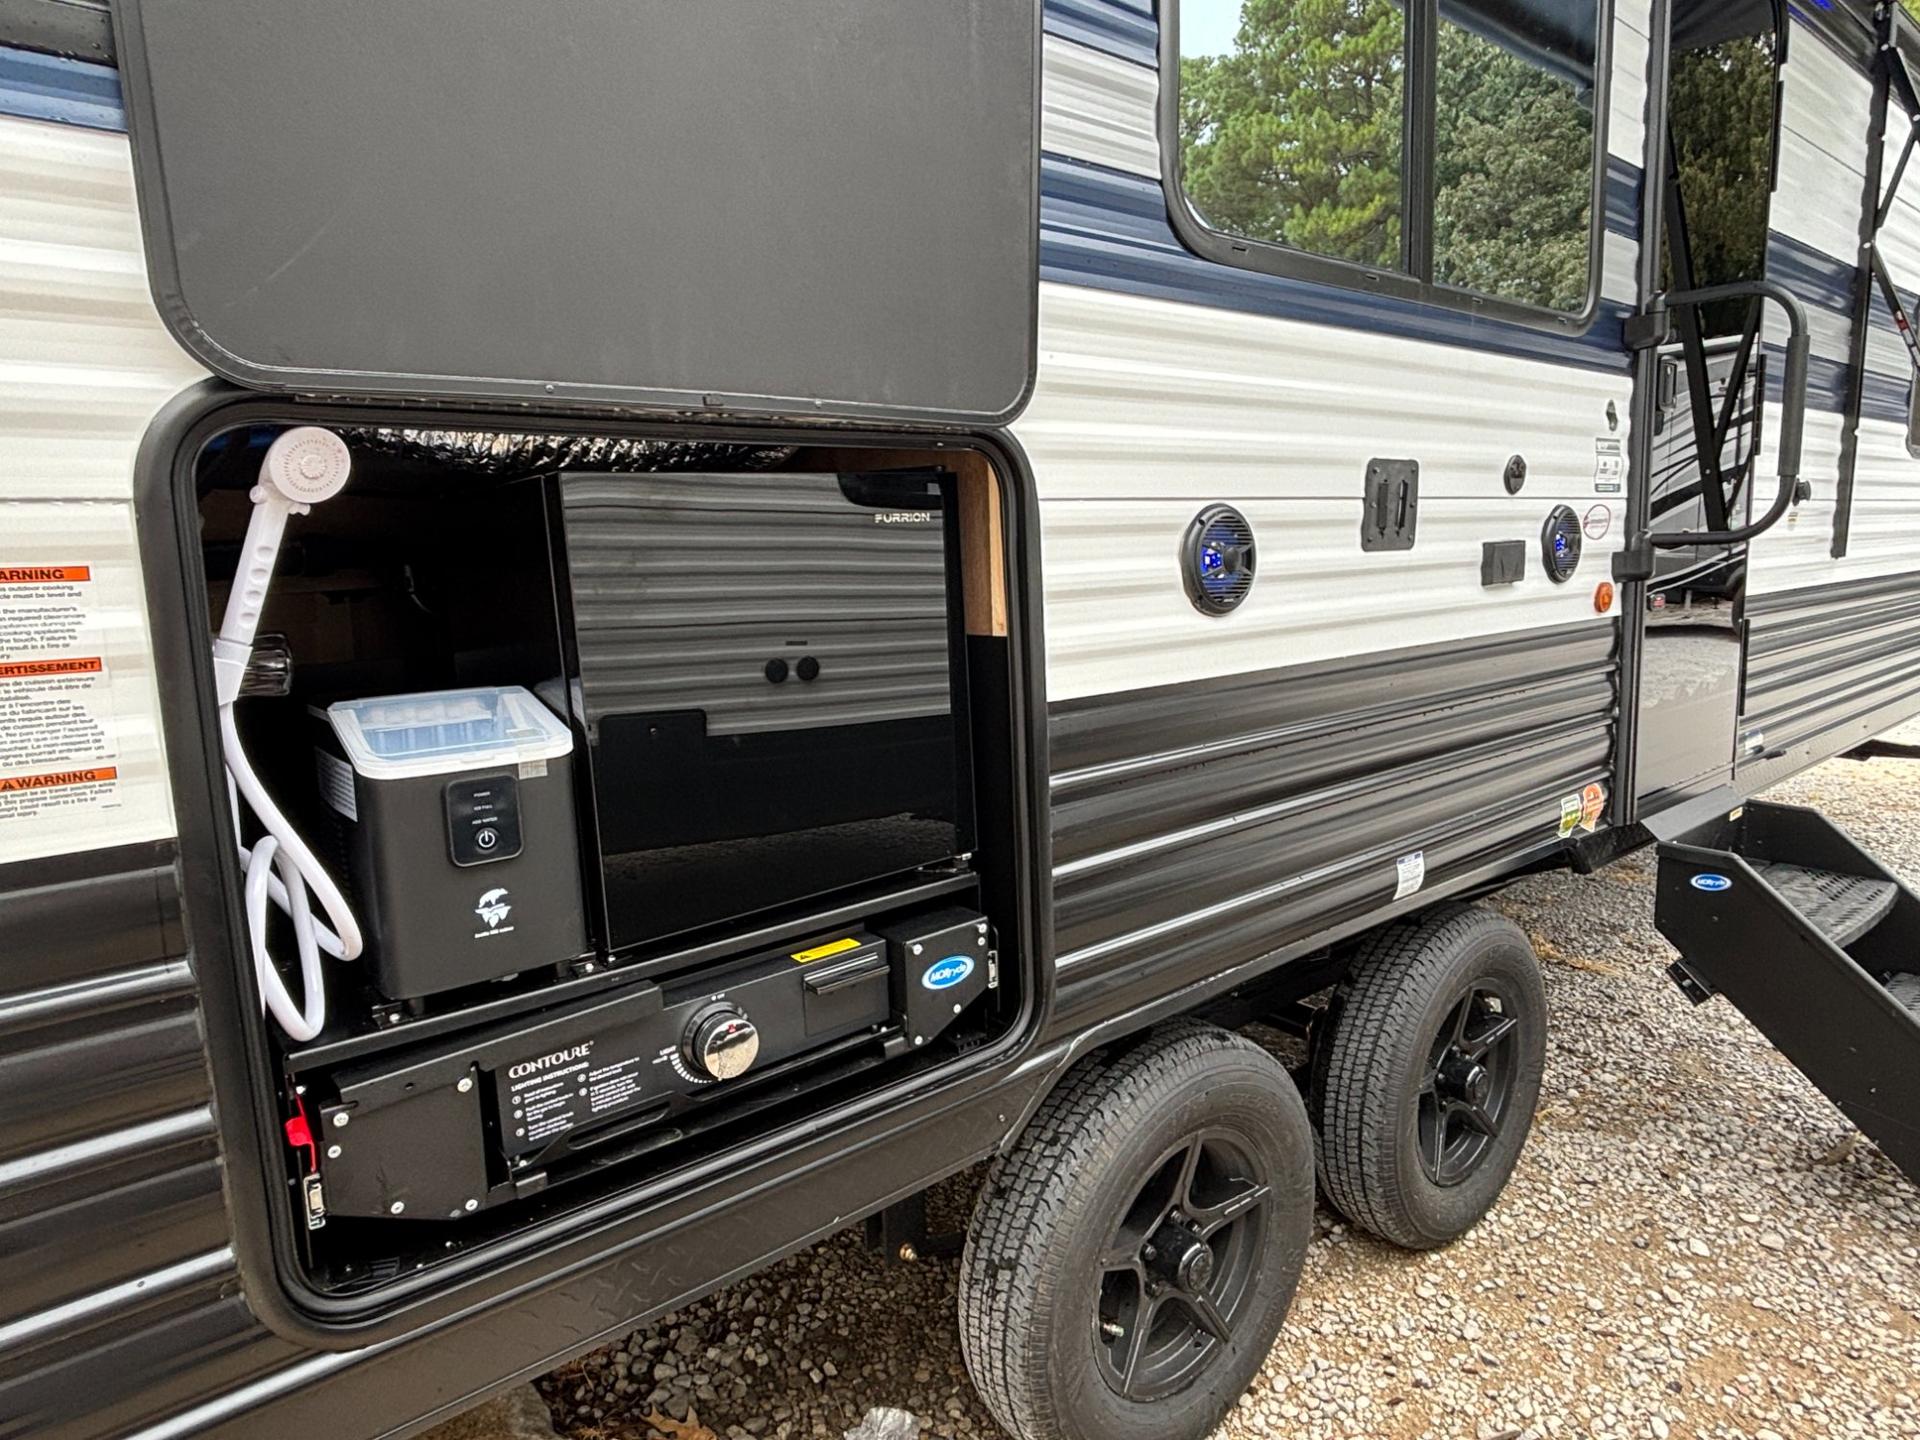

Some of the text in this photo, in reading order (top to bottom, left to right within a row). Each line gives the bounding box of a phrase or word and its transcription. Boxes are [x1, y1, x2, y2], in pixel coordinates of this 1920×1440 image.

[875, 512, 930, 523] FURRION
[16, 771, 96, 788] WARNING
[511, 1077, 542, 1092] LIGHTING
